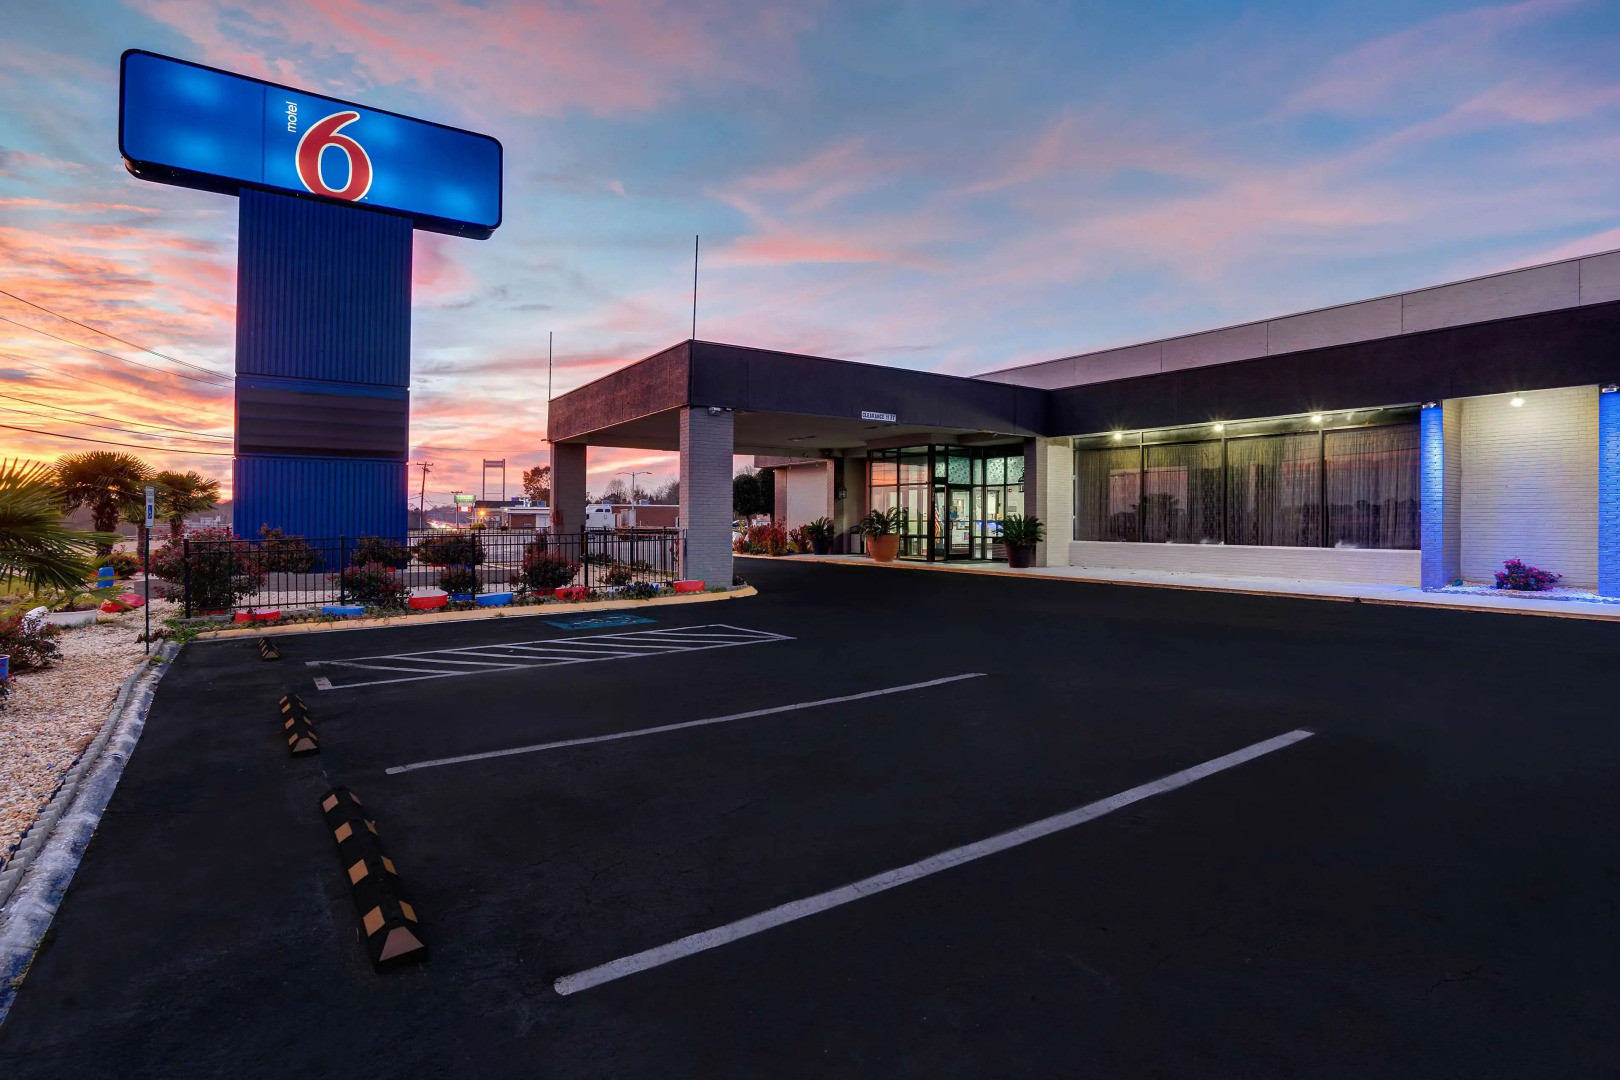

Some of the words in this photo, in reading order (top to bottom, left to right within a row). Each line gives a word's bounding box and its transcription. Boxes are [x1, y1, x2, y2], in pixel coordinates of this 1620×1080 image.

[285, 101, 298, 133] motel
[295, 110, 373, 202] 6
[862, 412, 884, 420] CLEARANCE
